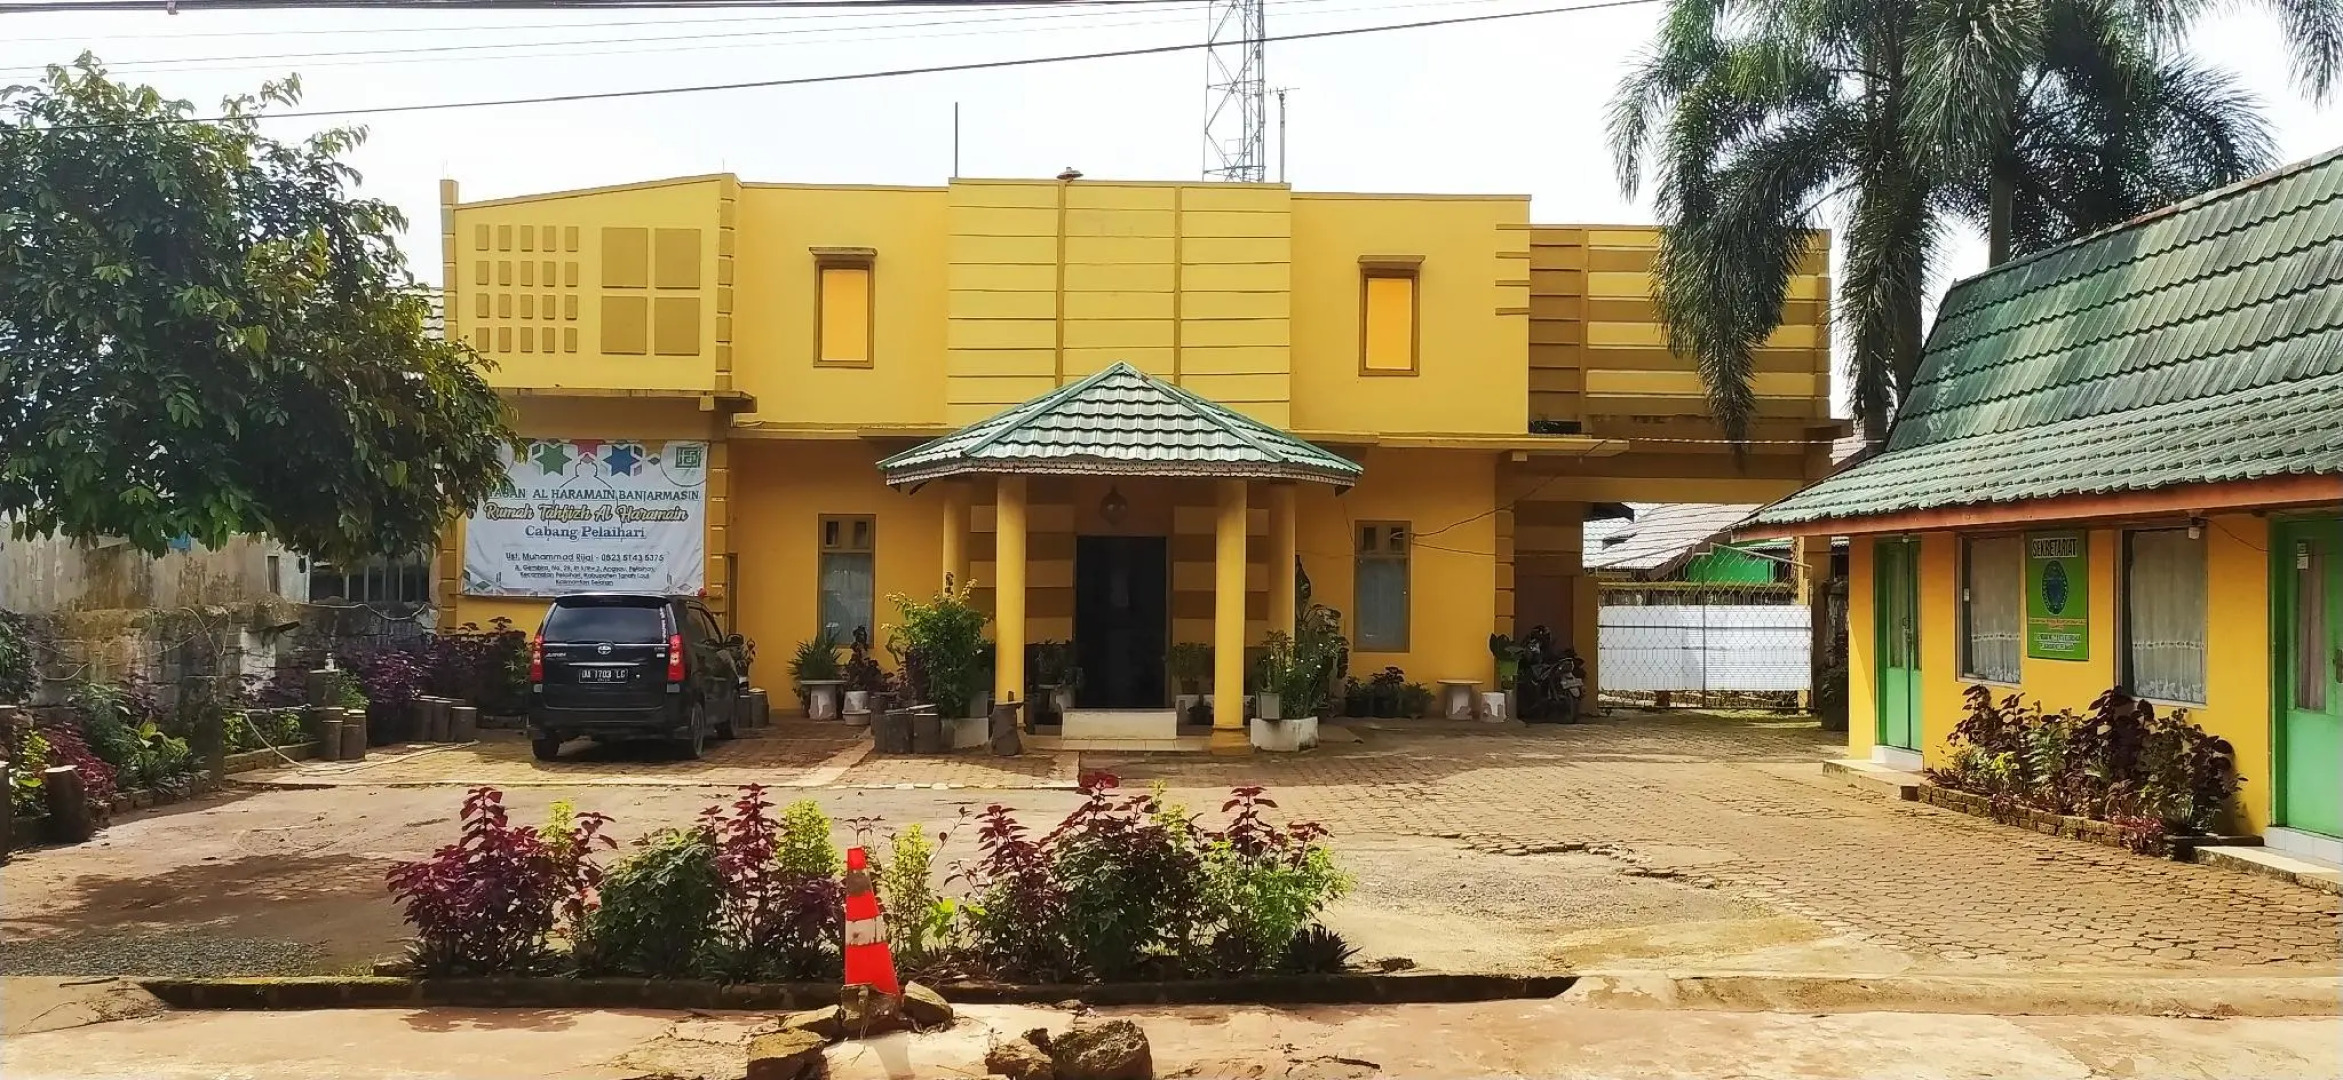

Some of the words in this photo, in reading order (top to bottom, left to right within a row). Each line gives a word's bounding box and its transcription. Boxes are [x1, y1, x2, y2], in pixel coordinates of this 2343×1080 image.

[533, 489, 548, 499] AL
[551, 489, 615, 500] HARAMAIN
[619, 490, 699, 501] BANJARMASIN
[483, 501, 534, 520] Rumah
[538, 503, 592, 523] Tahfizh
[594, 504, 613, 522] Al
[615, 504, 689, 523] Haramain
[525, 525, 578, 541] Cabang
[581, 526, 645, 538] Pelaihari
[2032, 539, 2077, 557] SEKRETARIAT
[522, 552, 574, 561] Muhammad
